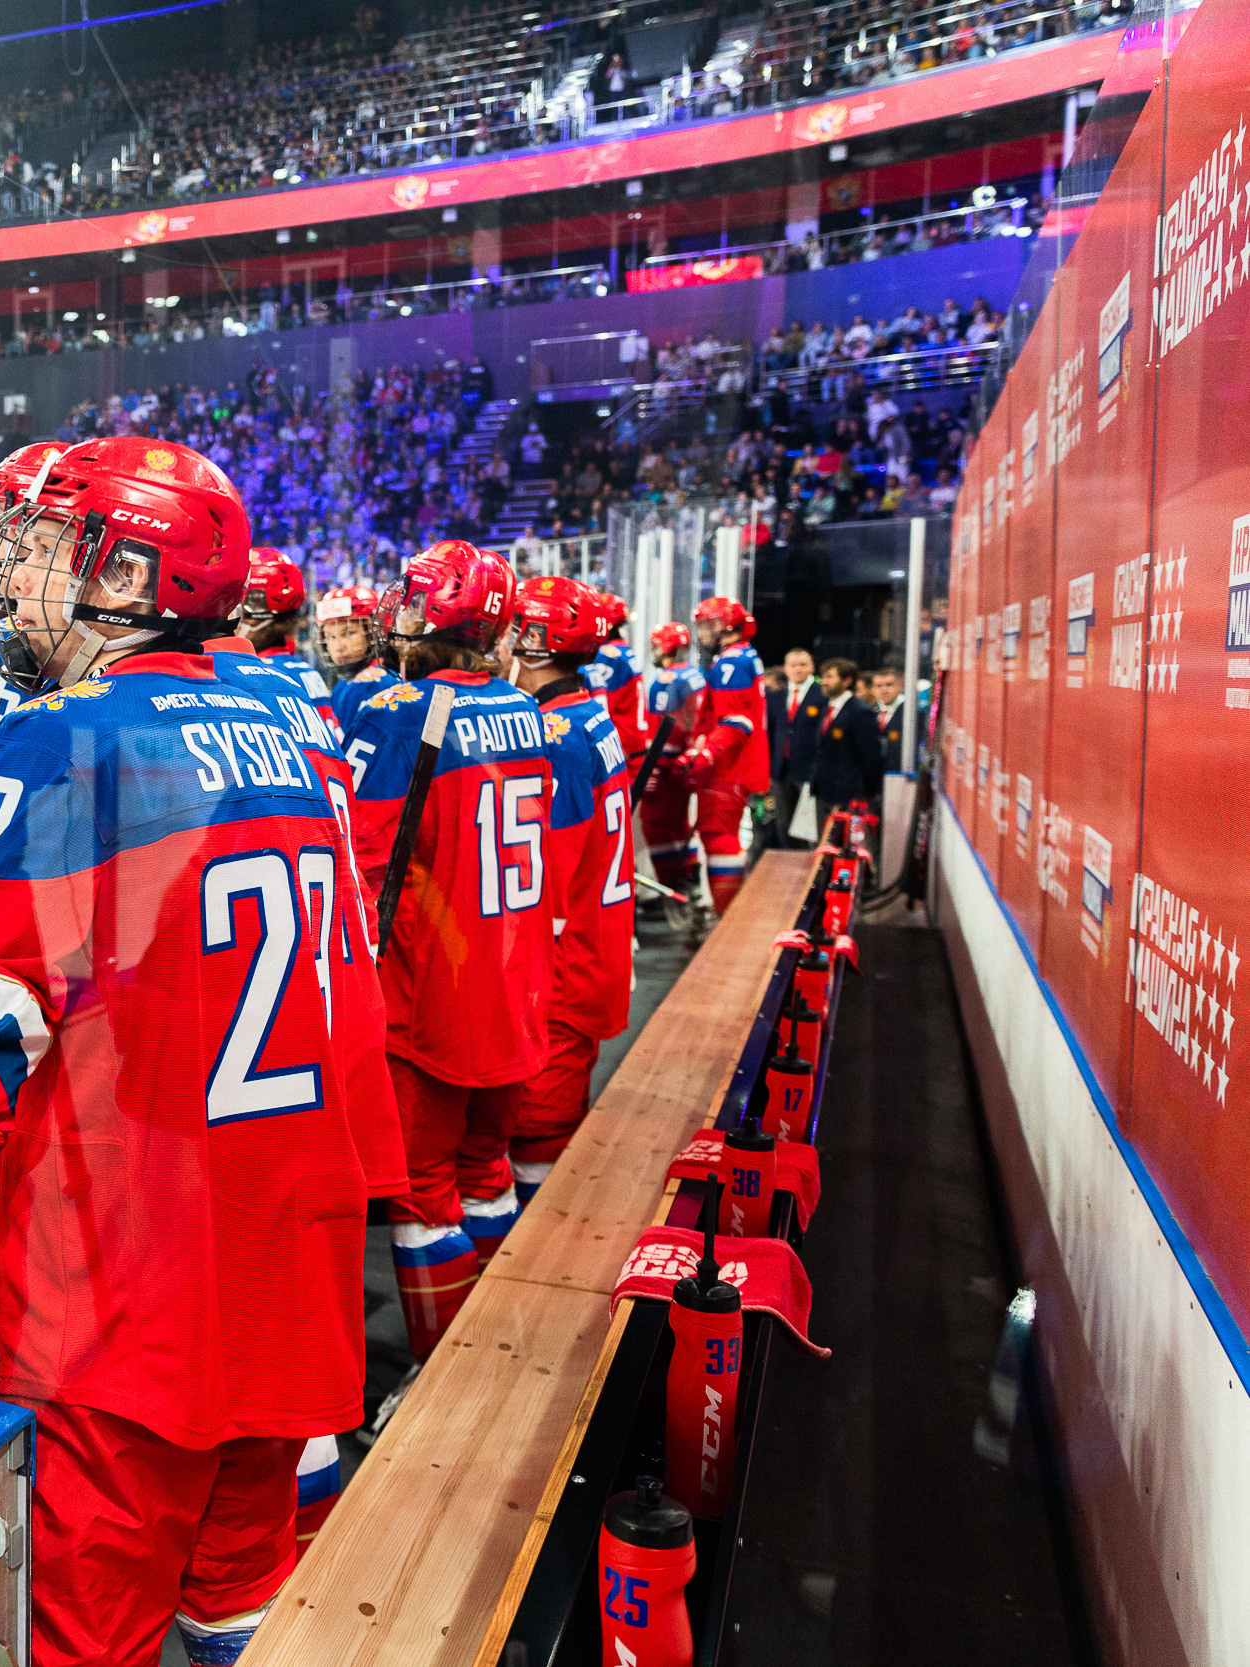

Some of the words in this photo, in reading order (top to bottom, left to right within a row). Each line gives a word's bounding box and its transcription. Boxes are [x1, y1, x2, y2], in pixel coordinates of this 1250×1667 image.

[111, 508, 172, 532] CCM
[72, 542, 89, 576] CCM
[411, 574, 434, 585] CCM
[484, 591, 503, 615] 15
[97, 614, 133, 625] CCM
[720, 664, 735, 685] 7
[150, 693, 206, 711] ВМЕСТЕ,
[454, 711, 542, 757] PAUTOV
[476, 776, 545, 918] 15
[784, 1088, 804, 1111] 17
[731, 1167, 761, 1198] 38
[705, 1337, 740, 1374] 33
[701, 1384, 723, 1497] CCM
[604, 1566, 649, 1628] 25
